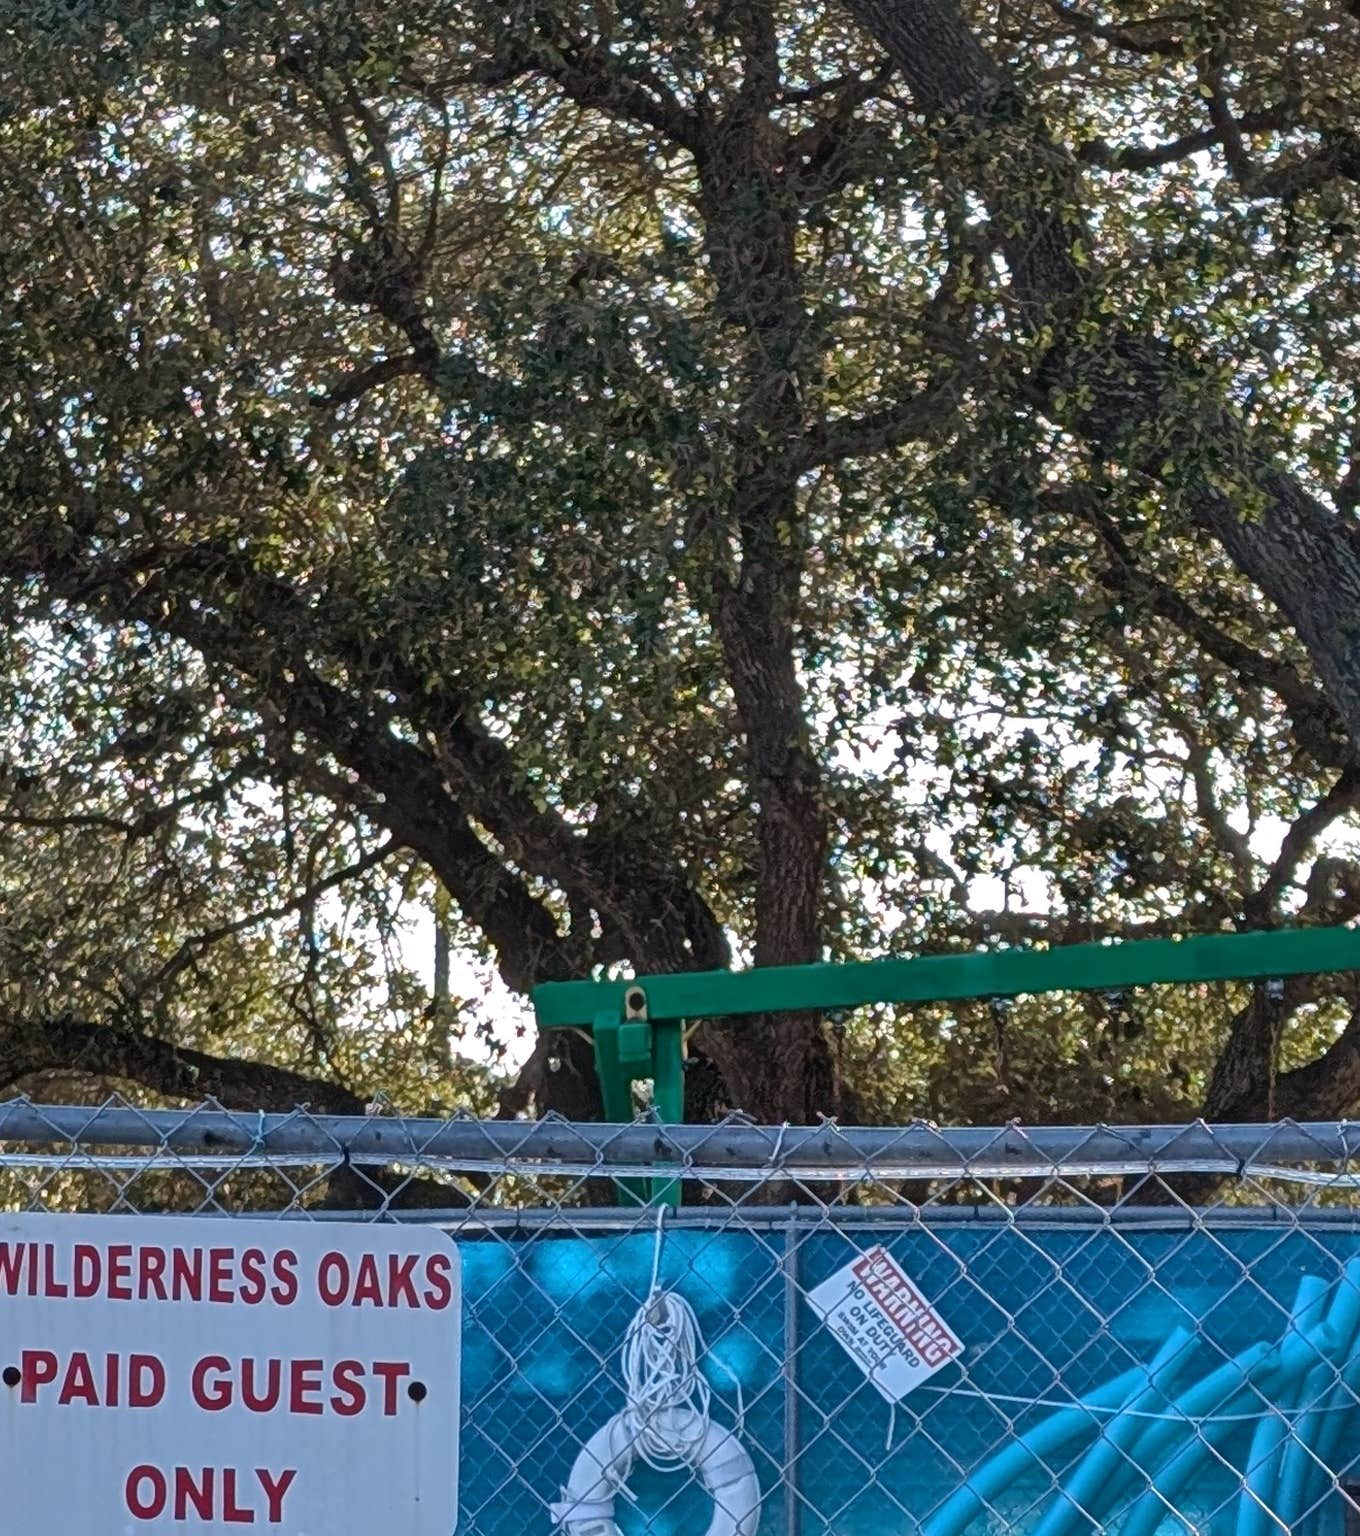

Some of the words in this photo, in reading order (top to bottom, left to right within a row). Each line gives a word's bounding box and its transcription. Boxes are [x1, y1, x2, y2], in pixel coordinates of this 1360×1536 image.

[317, 1250, 452, 1311] OAKS
[858, 1255, 953, 1363] WARNING
[846, 1280, 865, 1300] NO
[862, 1301, 920, 1369] LIFEGUARD
[849, 1306, 868, 1326] ON
[865, 1325, 896, 1359] DUTY
[20, 1350, 167, 1407] PAID
[191, 1355, 410, 1416] GUEST
[125, 1465, 296, 1523] ONLY
